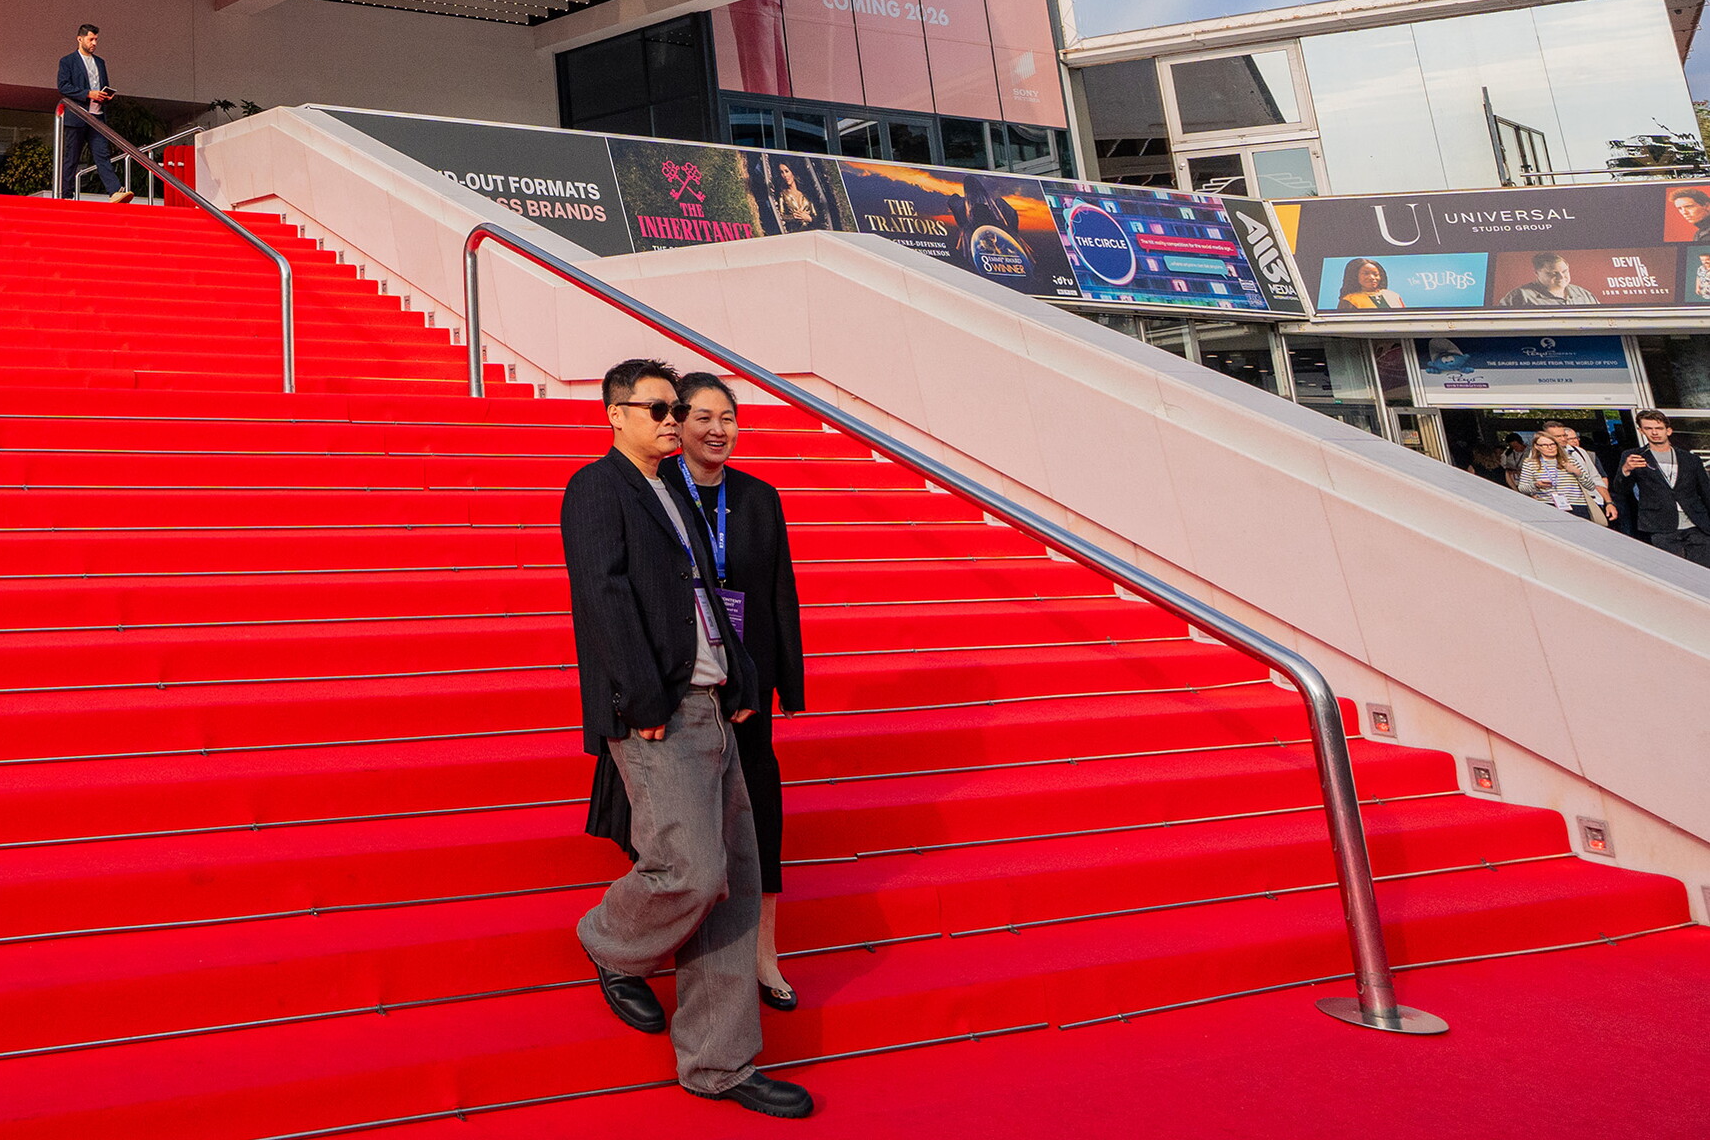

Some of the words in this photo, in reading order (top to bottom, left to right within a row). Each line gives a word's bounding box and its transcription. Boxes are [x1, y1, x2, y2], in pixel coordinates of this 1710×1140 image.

[904, 3, 950, 26] 2026
[508, 176, 601, 201] FORMATS
[526, 200, 607, 222] BRANDS
[679, 202, 705, 218] THE
[884, 199, 918, 216] THE
[1444, 208, 1575, 224] UNIVERSAL
[637, 215, 754, 242] INHERITANCE
[865, 214, 948, 237] TRAITORS
[1472, 225, 1511, 233] STUDIO
[1515, 223, 1553, 232] GROUP
[1076, 236, 1095, 248] THE
[1095, 238, 1128, 250] CIRCLE
[981, 255, 992, 272] 8
[991, 263, 1026, 274] WINNER
[1267, 284, 1297, 296] MEDIA
[1607, 276, 1658, 288] DISGUISE
